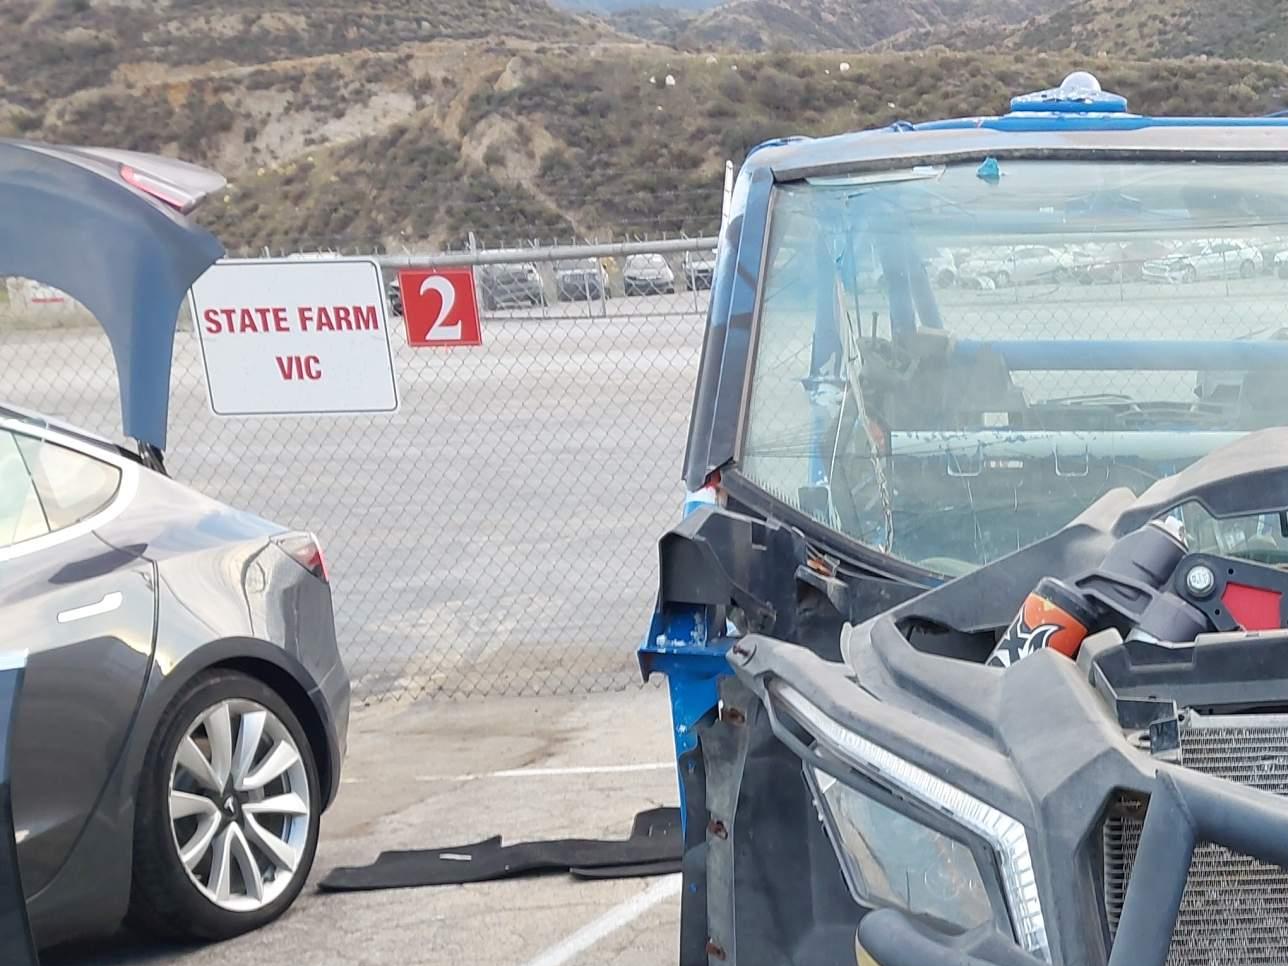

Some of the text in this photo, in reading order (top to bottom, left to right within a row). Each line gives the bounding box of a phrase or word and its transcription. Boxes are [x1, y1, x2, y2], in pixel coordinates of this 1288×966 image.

[204, 305, 380, 334] STATE FARM
[419, 275, 463, 341] 2
[275, 355, 322, 381] VIC
